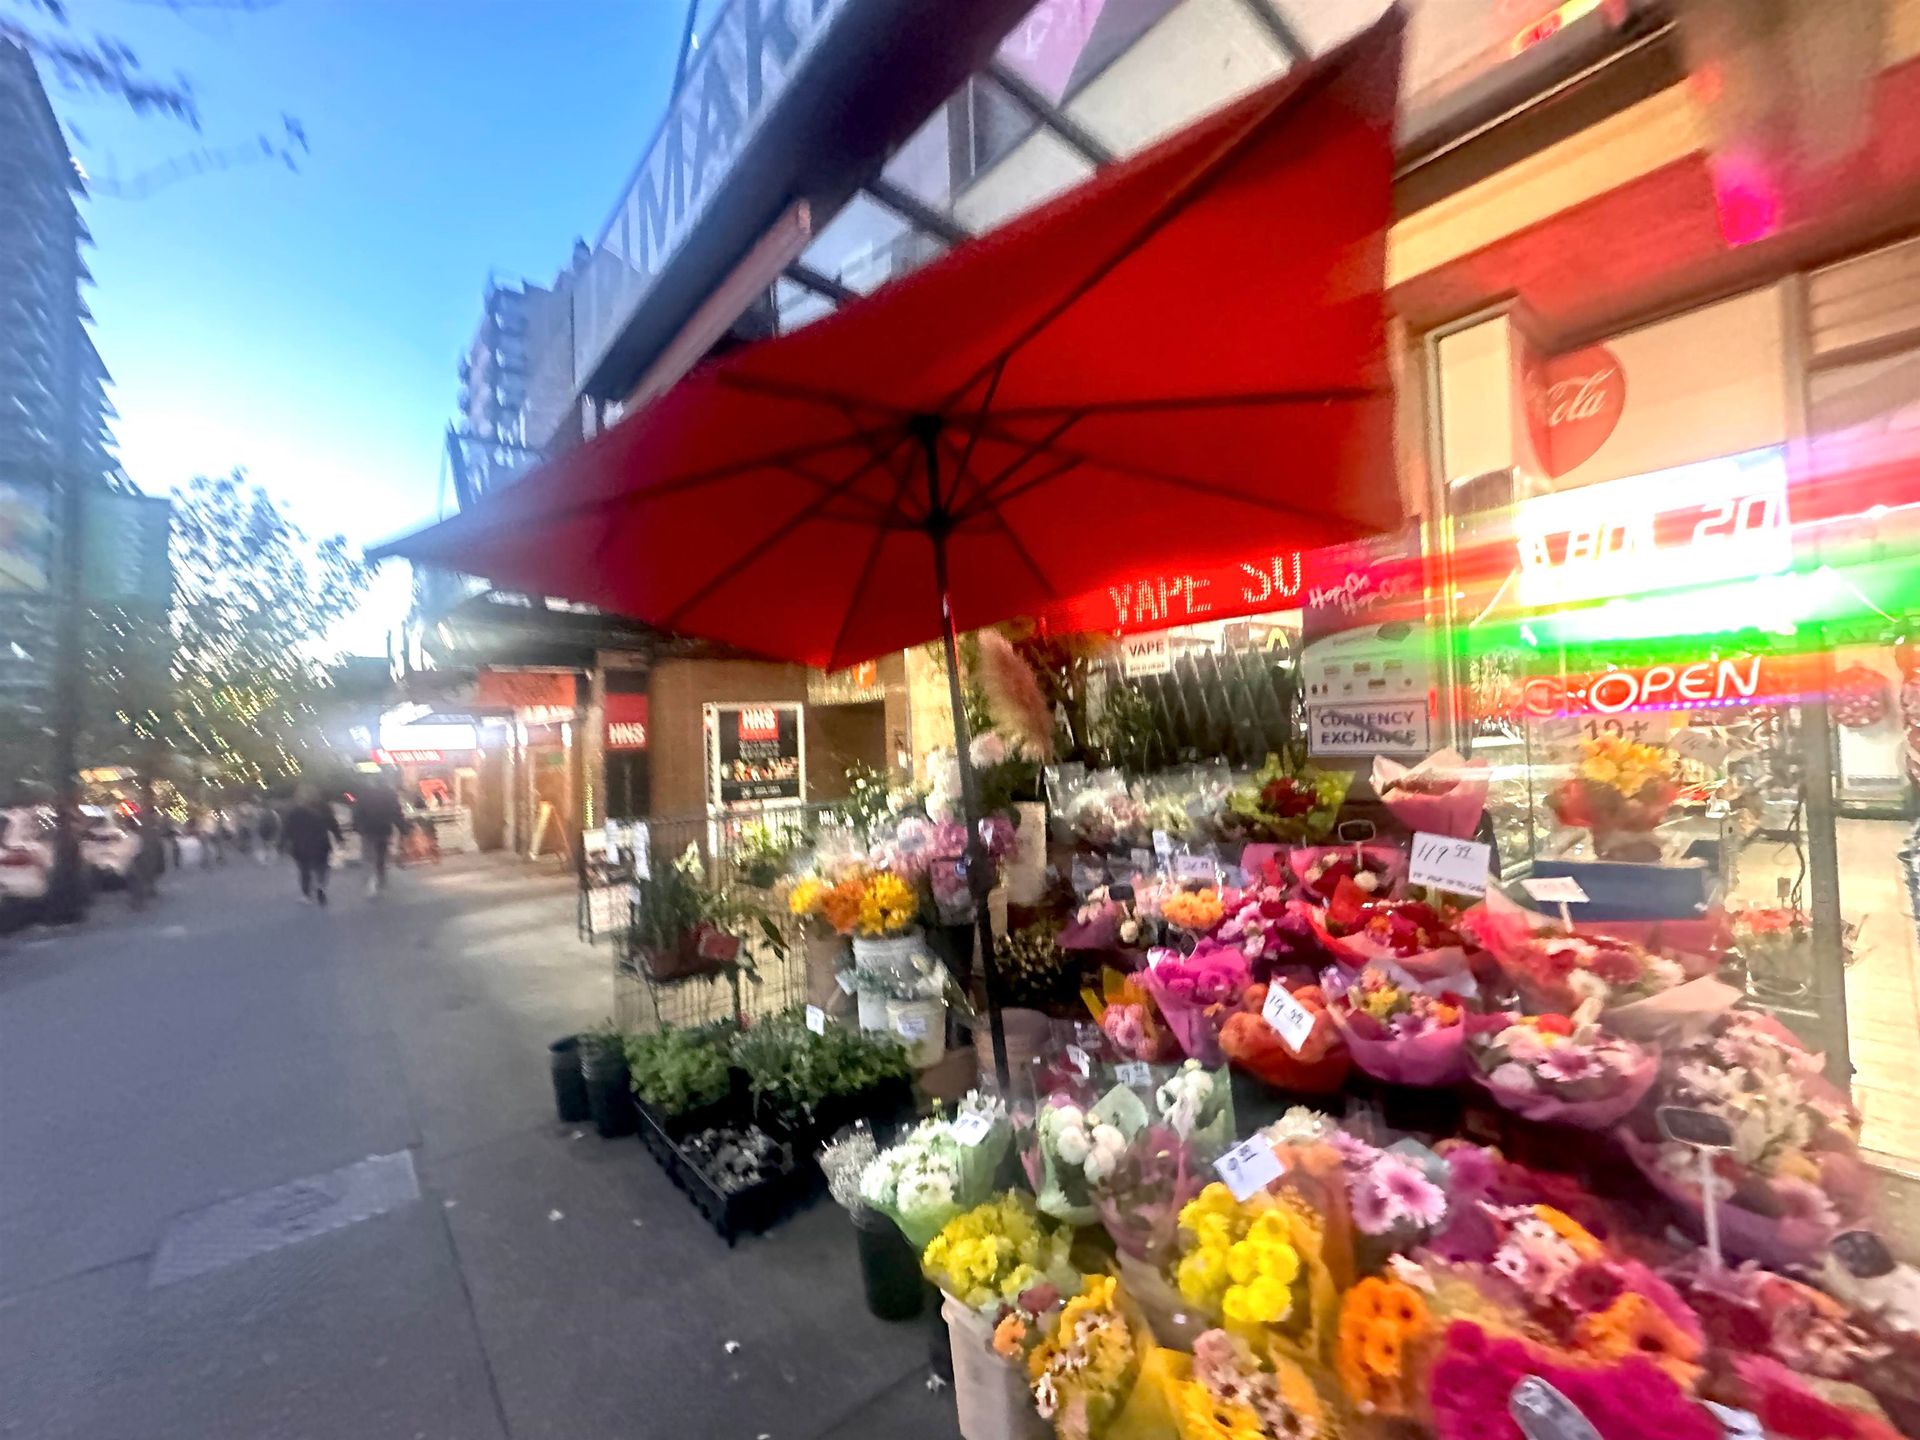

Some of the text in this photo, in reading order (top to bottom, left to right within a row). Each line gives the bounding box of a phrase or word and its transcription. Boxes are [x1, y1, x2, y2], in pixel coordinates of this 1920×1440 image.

[1110, 575, 1212, 625] VAPE
[1129, 640, 1165, 658] VAPE
[1590, 656, 1761, 714] OPEN
